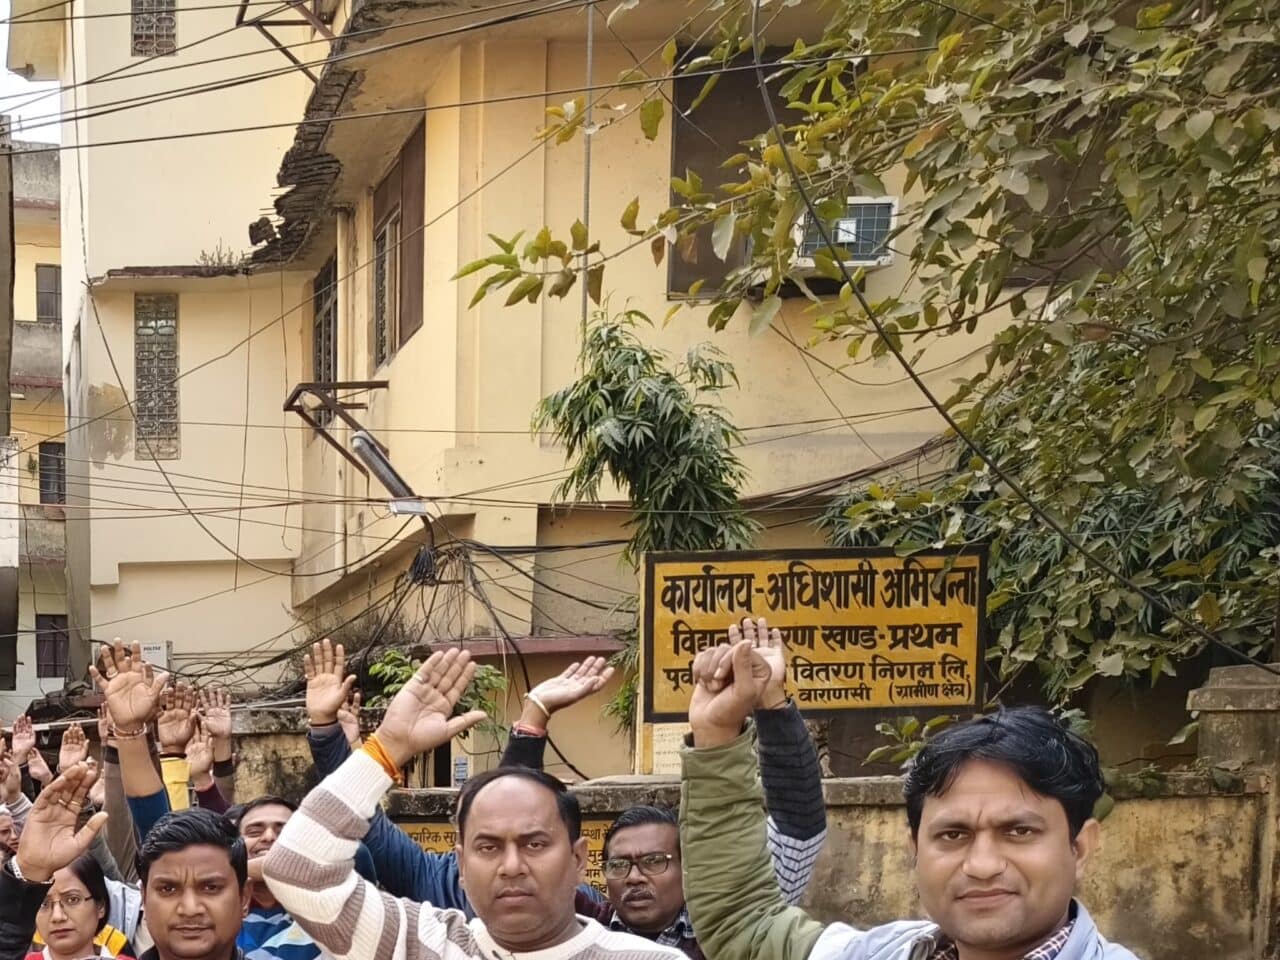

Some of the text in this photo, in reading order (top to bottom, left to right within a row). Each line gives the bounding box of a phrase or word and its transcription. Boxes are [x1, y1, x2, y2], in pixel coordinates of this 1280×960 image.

[791, 655, 865, 683] वितरण
[869, 654, 937, 681] निगम
[798, 684, 872, 704] वाराणसी
